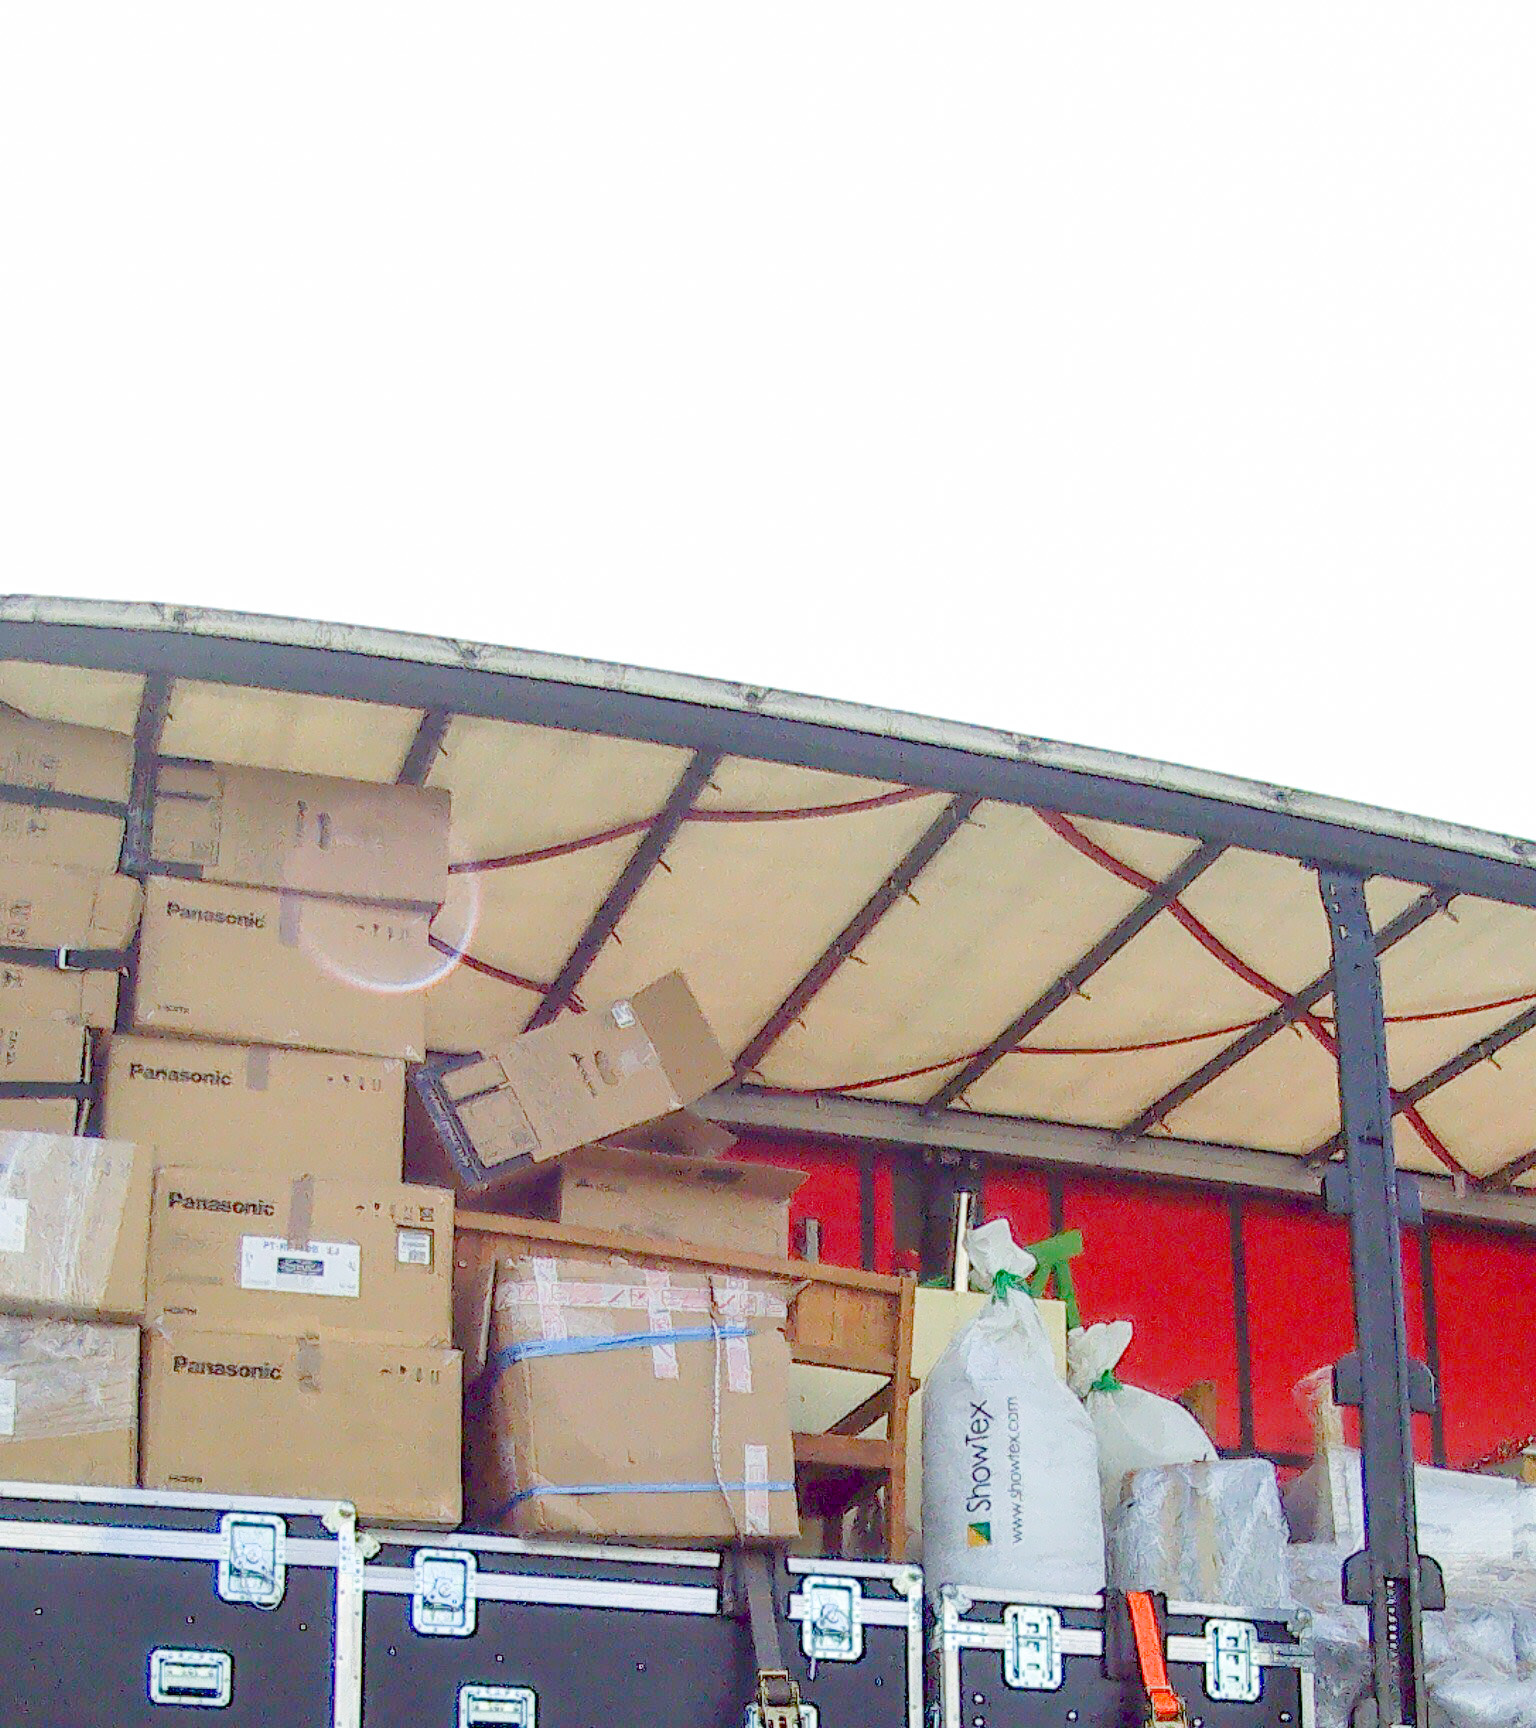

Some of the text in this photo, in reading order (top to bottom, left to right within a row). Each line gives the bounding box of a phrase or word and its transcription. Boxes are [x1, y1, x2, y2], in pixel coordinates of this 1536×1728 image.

[166, 900, 265, 929] Panasonic
[129, 1061, 233, 1087] Panasonic
[168, 1191, 276, 1217] Panasonic
[172, 1354, 283, 1381] Panasonic
[965, 1399, 994, 1513] ShowTex
[1006, 1396, 1023, 1544] www.showtex.com
